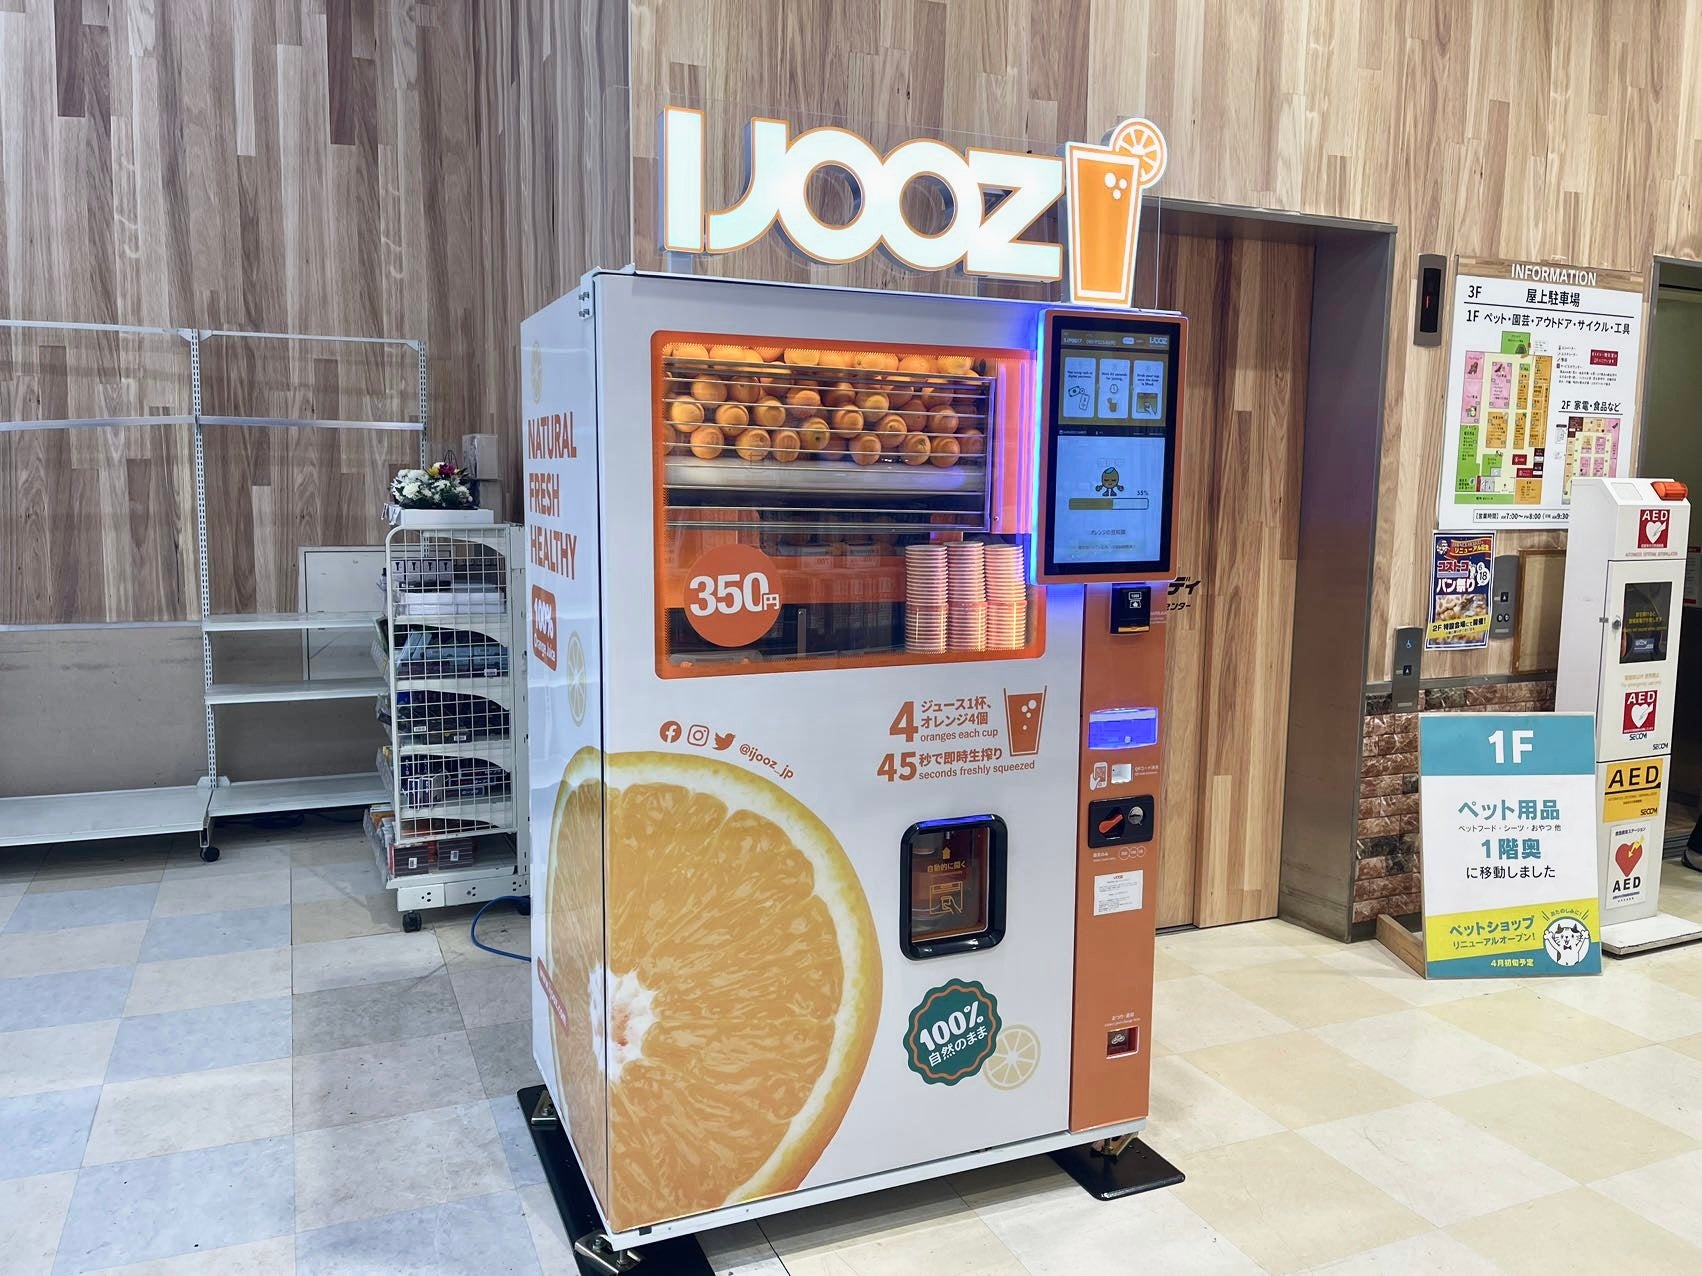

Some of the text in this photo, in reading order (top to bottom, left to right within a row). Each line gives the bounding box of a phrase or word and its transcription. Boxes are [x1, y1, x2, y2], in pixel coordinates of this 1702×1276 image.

[664, 105, 1066, 281] IJOOZ
[1511, 263, 1597, 287] INFORMATION
[1467, 284, 1581, 308] 3F 屋上駐車場
[1466, 309, 1480, 323] 1F
[1561, 400, 1621, 413] 2F 家電・食品など
[528, 411, 577, 460] NATURAL
[529, 472, 560, 518] FRESH
[1641, 510, 1669, 521] AED
[530, 524, 577, 580] HEALTHY
[1437, 560, 1471, 573] コストコ
[1479, 570, 1488, 581] 18
[689, 571, 780, 617] 350円
[534, 597, 554, 640] 100%
[1626, 691, 1656, 705] AED
[889, 700, 919, 743] 4
[920, 711, 989, 729] オレンジ4個
[920, 728, 999, 743] oranges each cup
[1487, 729, 1534, 764] 1F
[738, 743, 794, 781] @ijooz_jp
[876, 747, 1003, 783] 45 秒で即時生搾り
[918, 759, 1036, 780] seconds freshly squeezed
[1607, 765, 1660, 790] AED
[1458, 799, 1561, 822] ペット用品
[1554, 824, 1562, 832] 他
[1481, 838, 1542, 861] 1階奥
[1466, 864, 1556, 880] に移動しました
[1612, 876, 1642, 893] AED
[1449, 915, 1535, 937] ペットショップ
[1490, 958, 1535, 968] 4月初旬予定
[919, 1000, 985, 1052] 100%
[928, 1025, 989, 1068] 自然のまま
